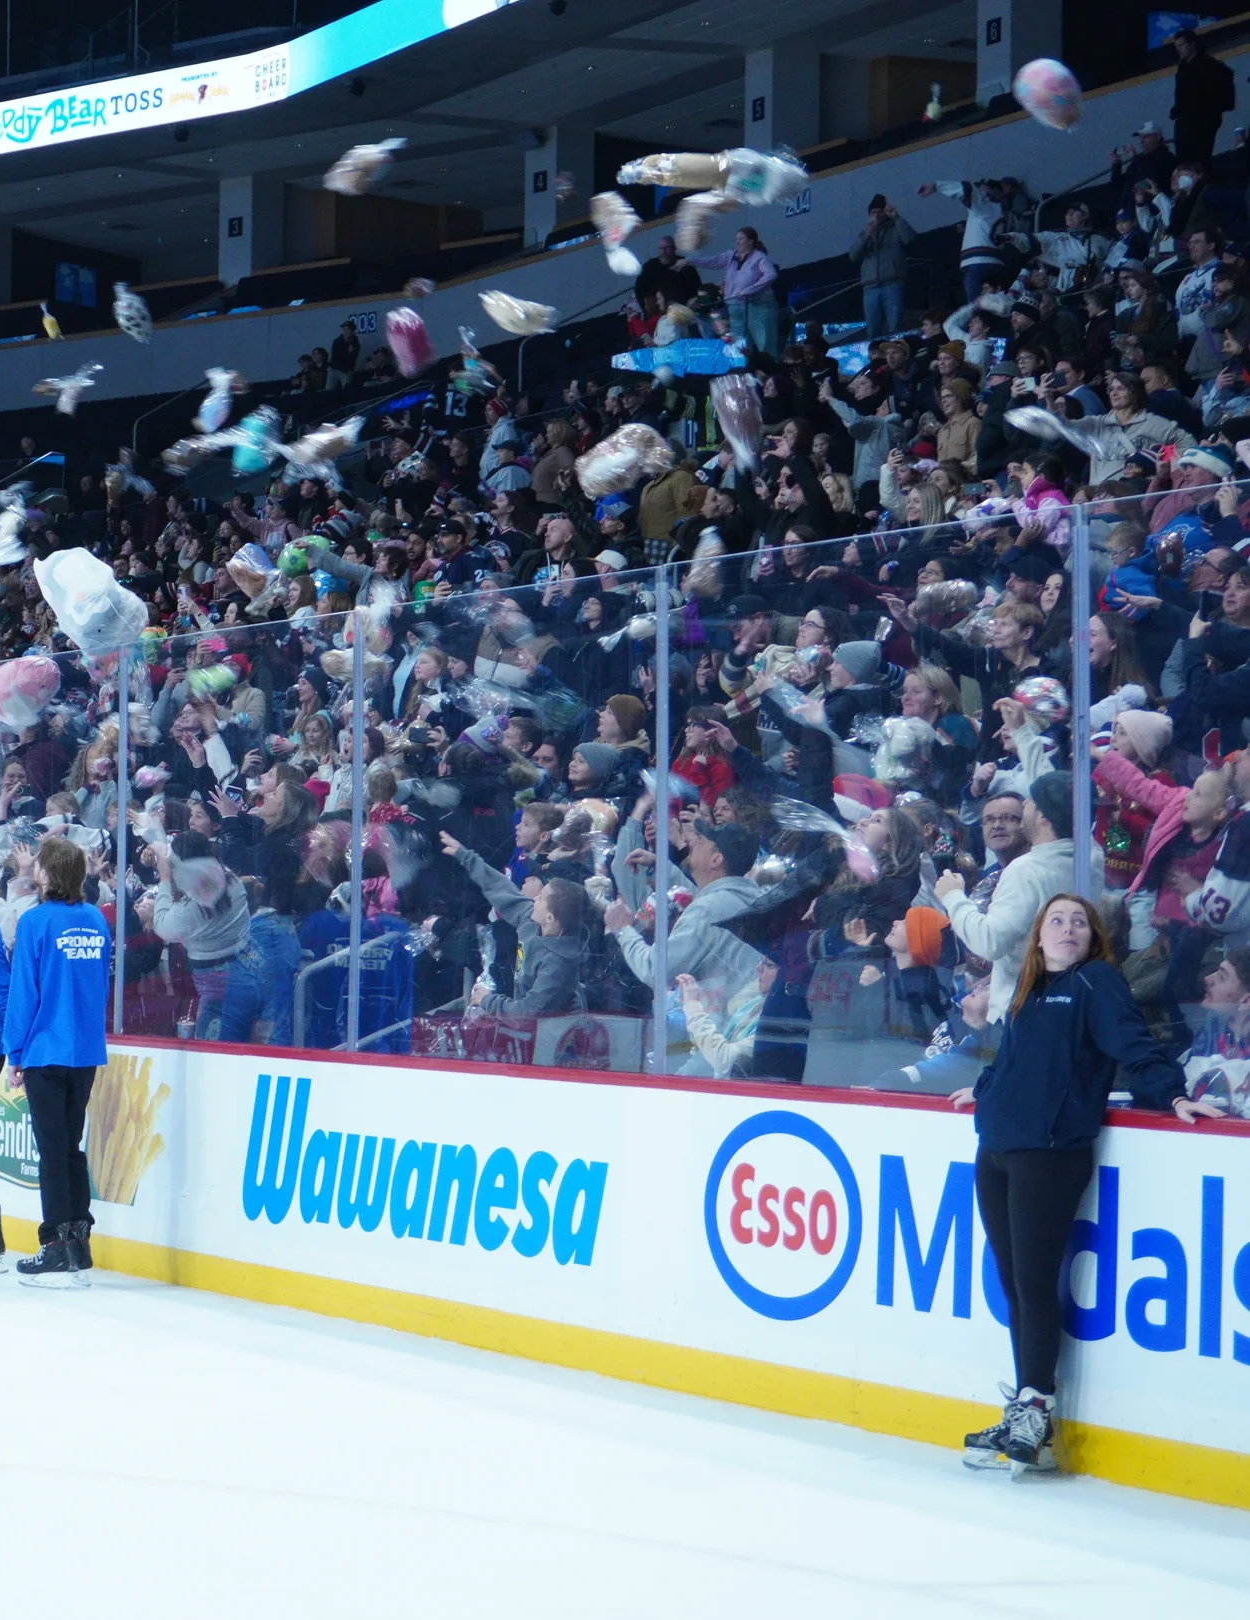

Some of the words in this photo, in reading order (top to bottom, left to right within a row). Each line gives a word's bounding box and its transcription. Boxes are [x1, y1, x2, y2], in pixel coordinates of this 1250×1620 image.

[990, 22, 998, 40] 6
[255, 58, 287, 78] CHEER
[255, 73, 287, 93] BOARD
[110, 88, 163, 115] TOSS
[536, 173, 545, 190] 4
[231, 219, 240, 235] 3
[445, 391, 468, 417] 13
[1201, 886, 1231, 925] 13
[56, 935, 105, 949] PROMO
[63, 947, 101, 959] TEAM
[20, 1162, 39, 1178] Farms
[242, 1074, 608, 1266] Wawanesa
[730, 1162, 837, 1255] Esso
